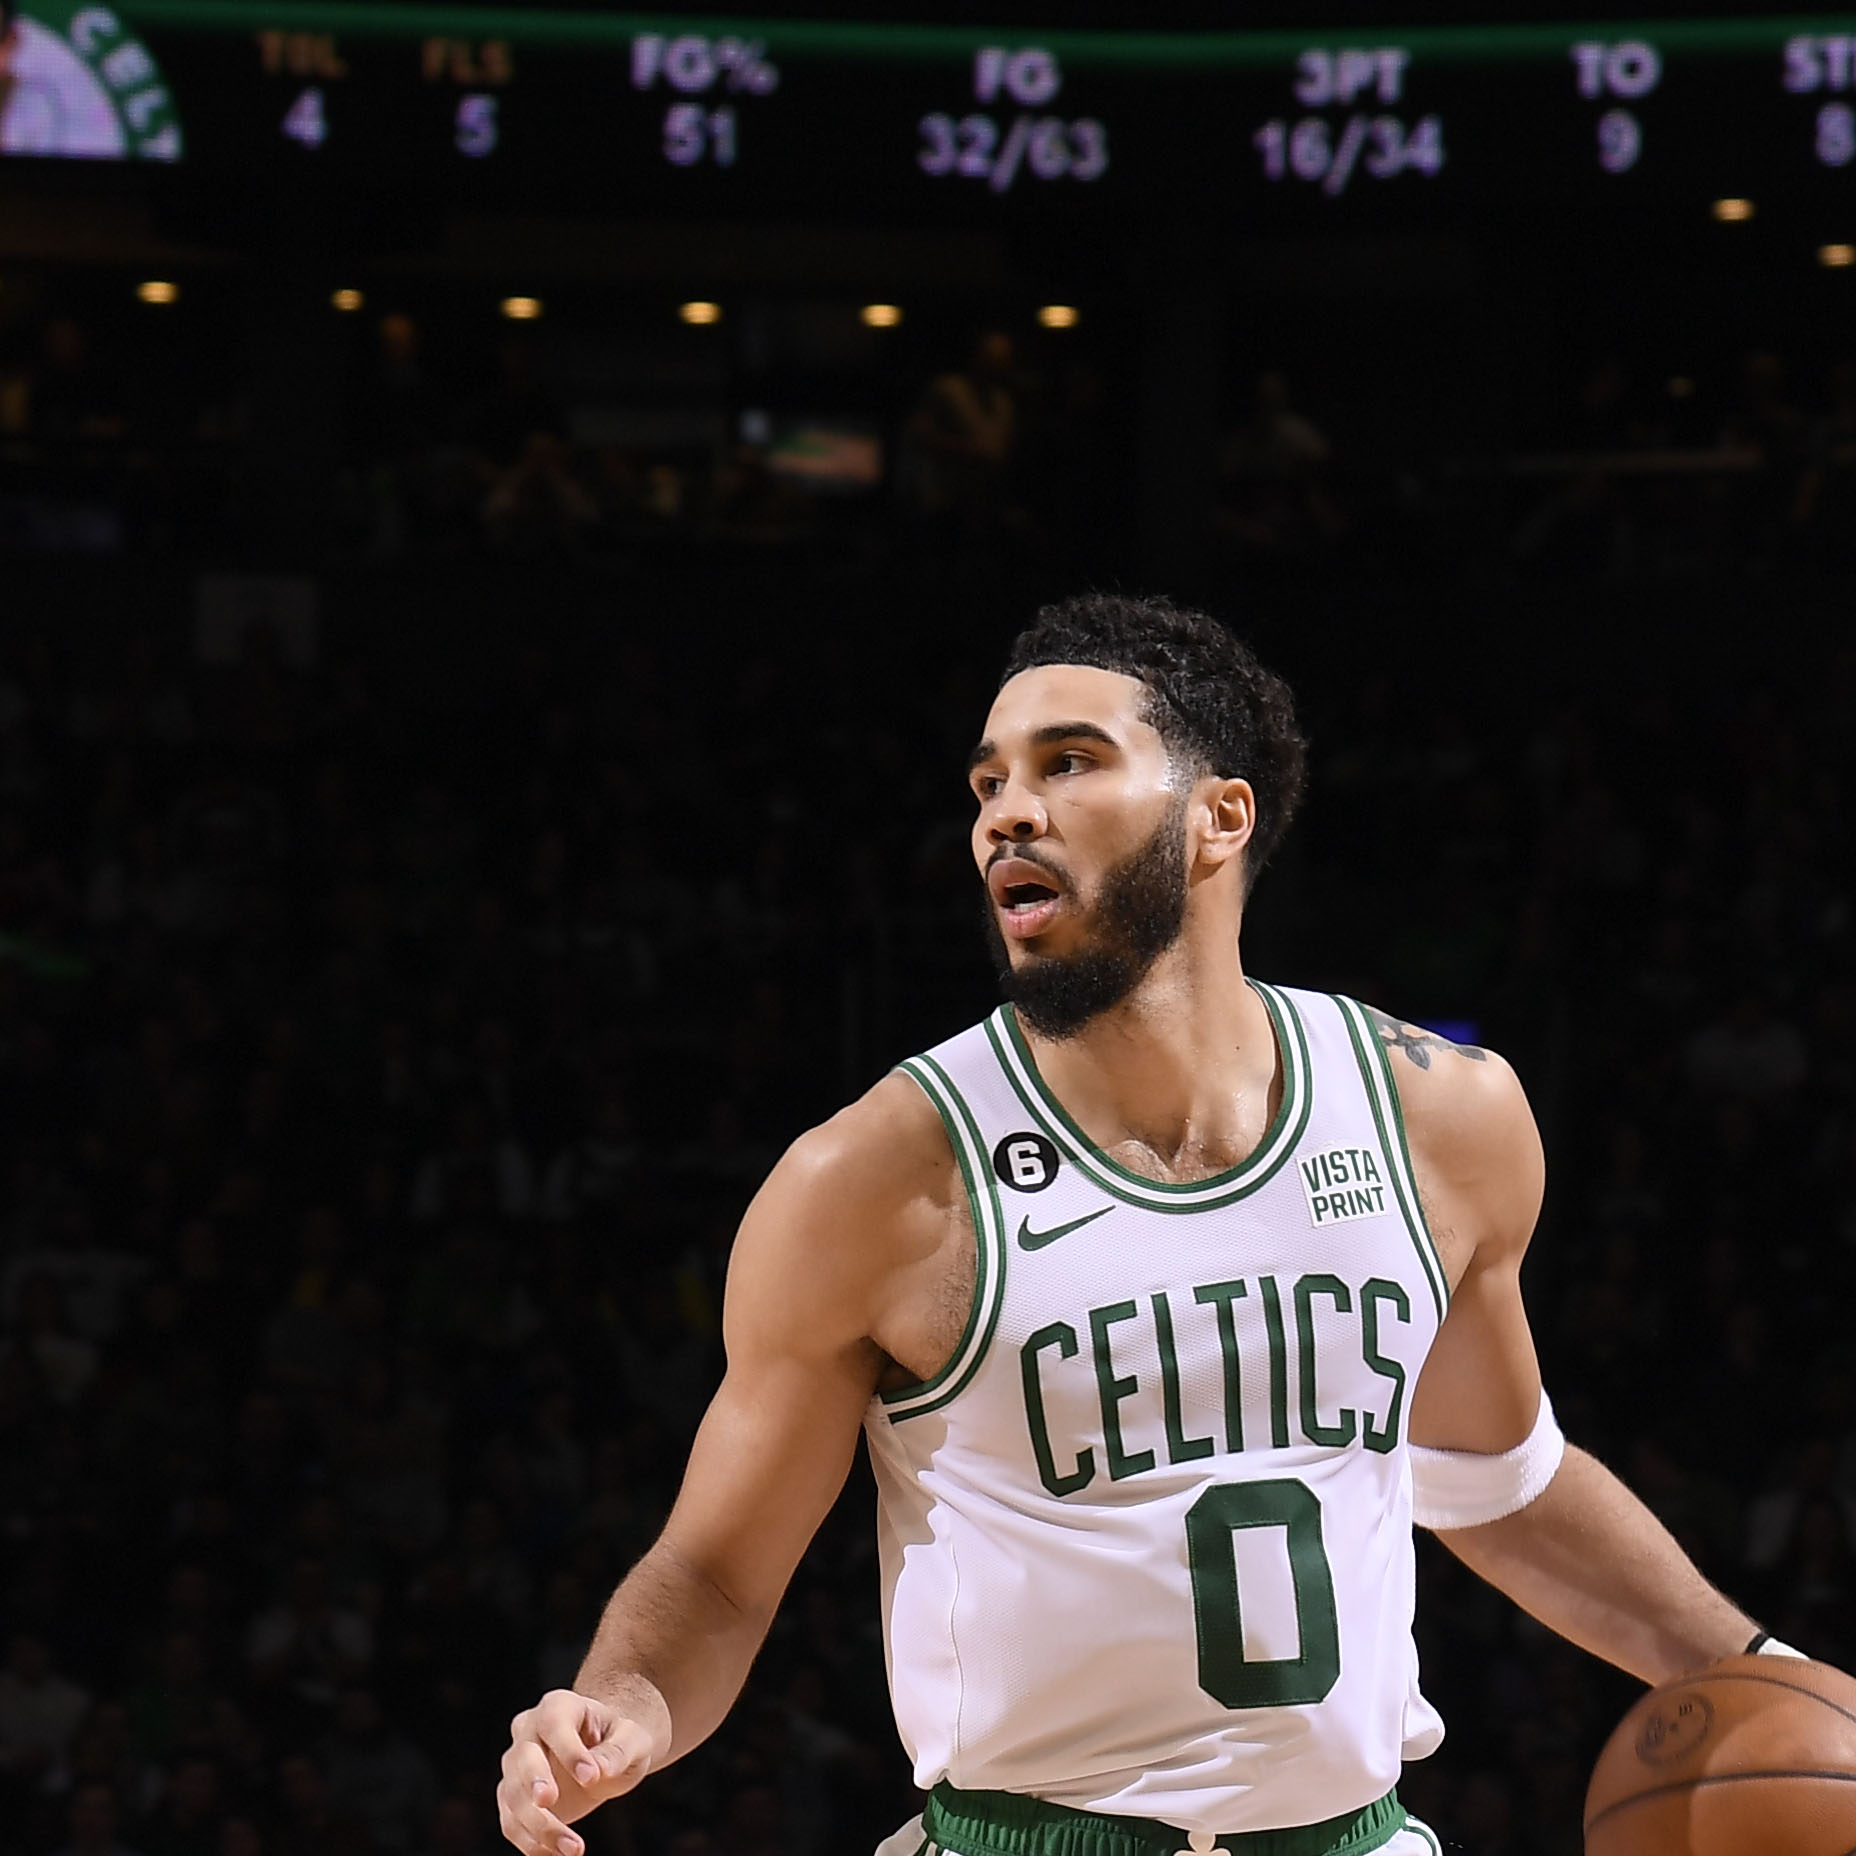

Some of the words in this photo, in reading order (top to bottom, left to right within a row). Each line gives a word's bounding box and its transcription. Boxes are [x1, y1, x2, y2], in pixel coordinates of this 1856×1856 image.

[630, 32, 779, 94] FG%
[972, 46, 1061, 105] FG
[1294, 46, 1410, 106] 3PT
[1570, 40, 1660, 98] TO
[281, 86, 328, 150] 4
[455, 94, 497, 158] 5
[663, 102, 737, 167] 51
[918, 112, 1108, 191] 32/63
[1254, 114, 1445, 195] 16/34
[1598, 109, 1641, 173] 9
[1007, 1141, 1045, 1187] 6
[1301, 1149, 1382, 1193] VISTA
[1311, 1186, 1385, 1222] PRINT
[1020, 1273, 1411, 1498] CELTICS
[1184, 1477, 1341, 1709] 0
